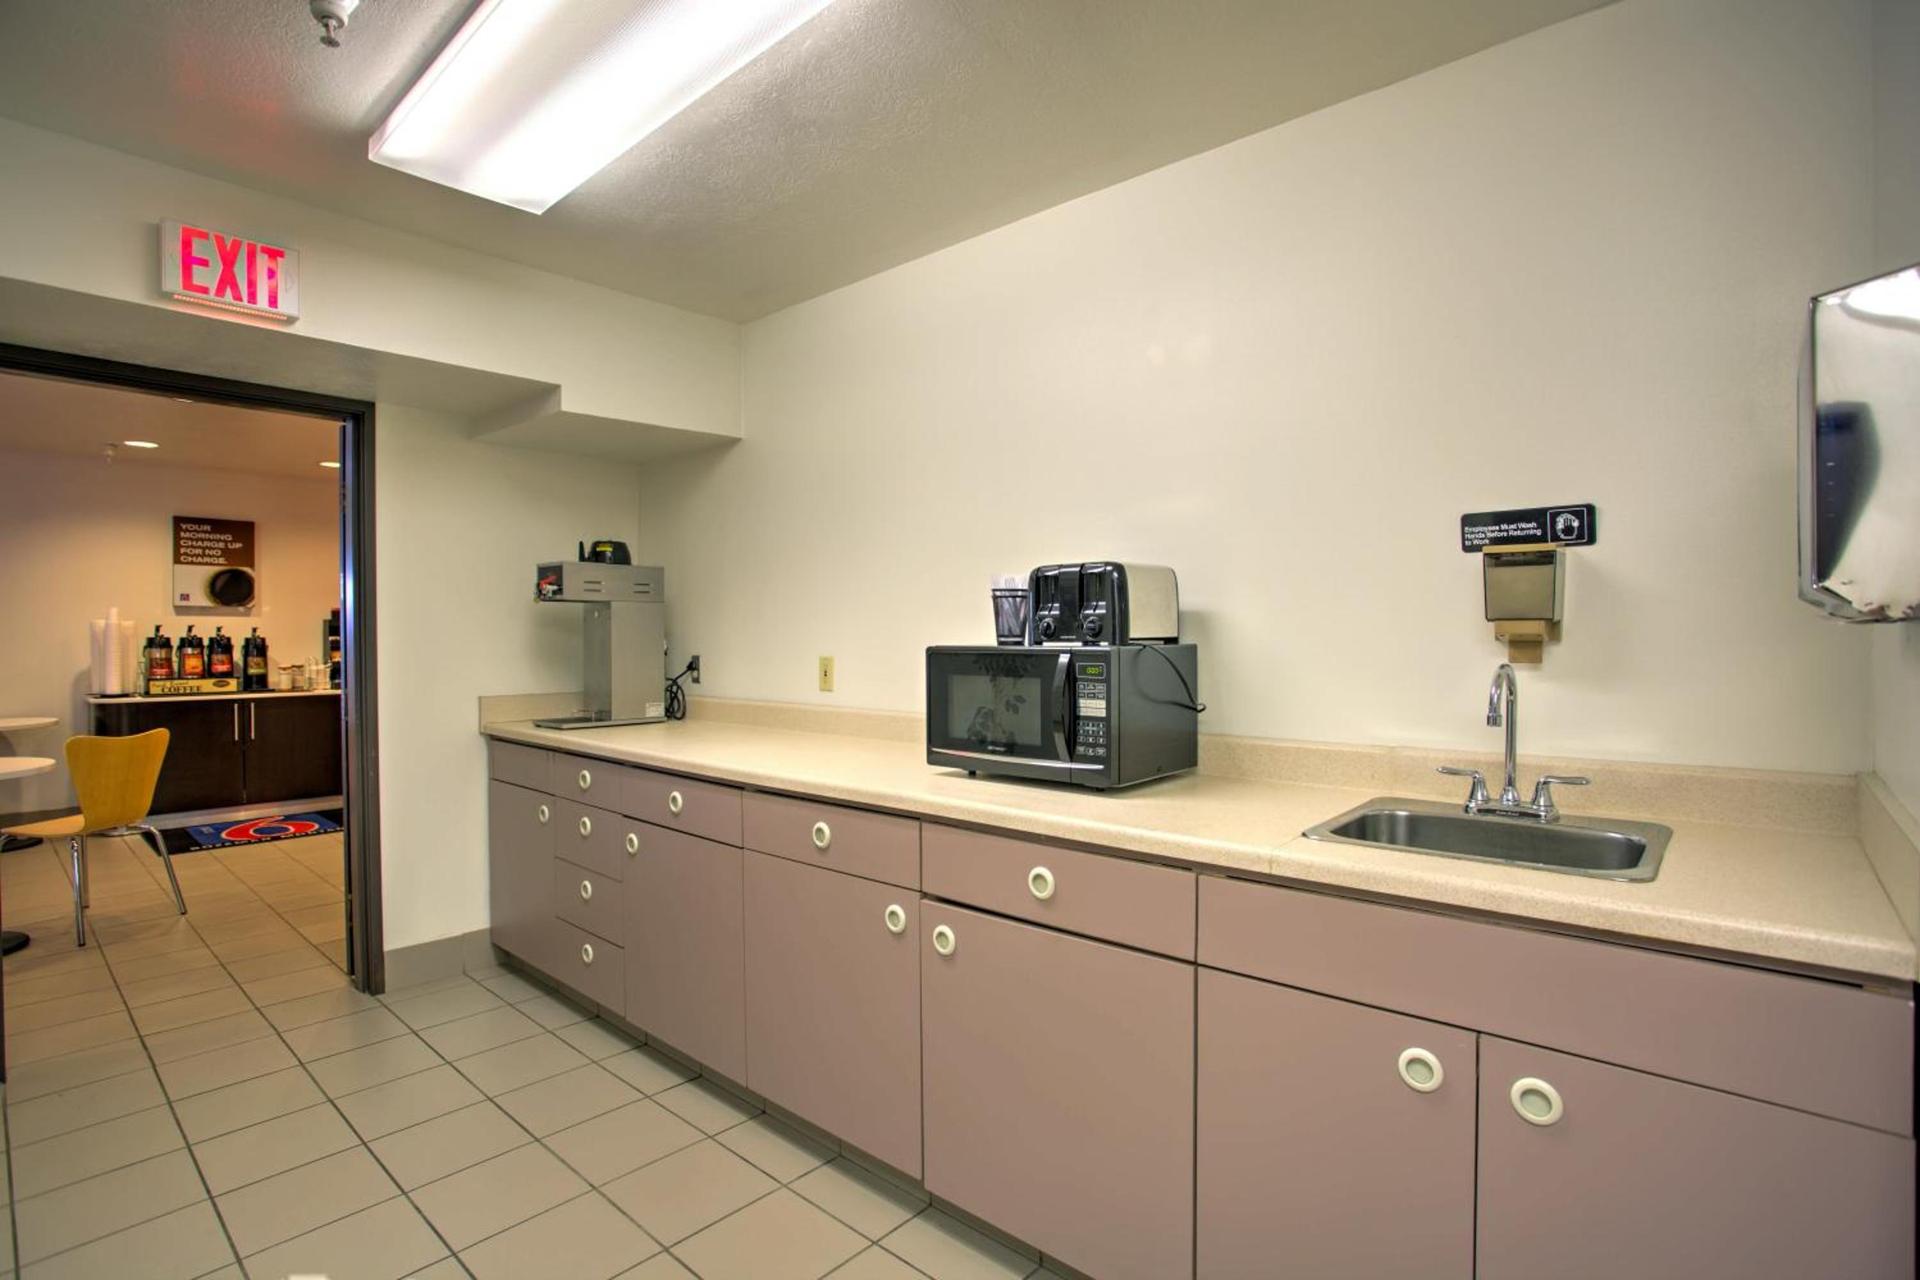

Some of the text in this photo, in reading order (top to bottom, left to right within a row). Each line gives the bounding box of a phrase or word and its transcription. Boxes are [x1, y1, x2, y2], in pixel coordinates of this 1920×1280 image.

[181, 225, 285, 309] EXIT
[180, 523, 211, 531] YOUR
[180, 532, 233, 540] MORNING
[180, 540, 225, 548] CHARGE
[180, 555, 228, 564] CHARGE.
